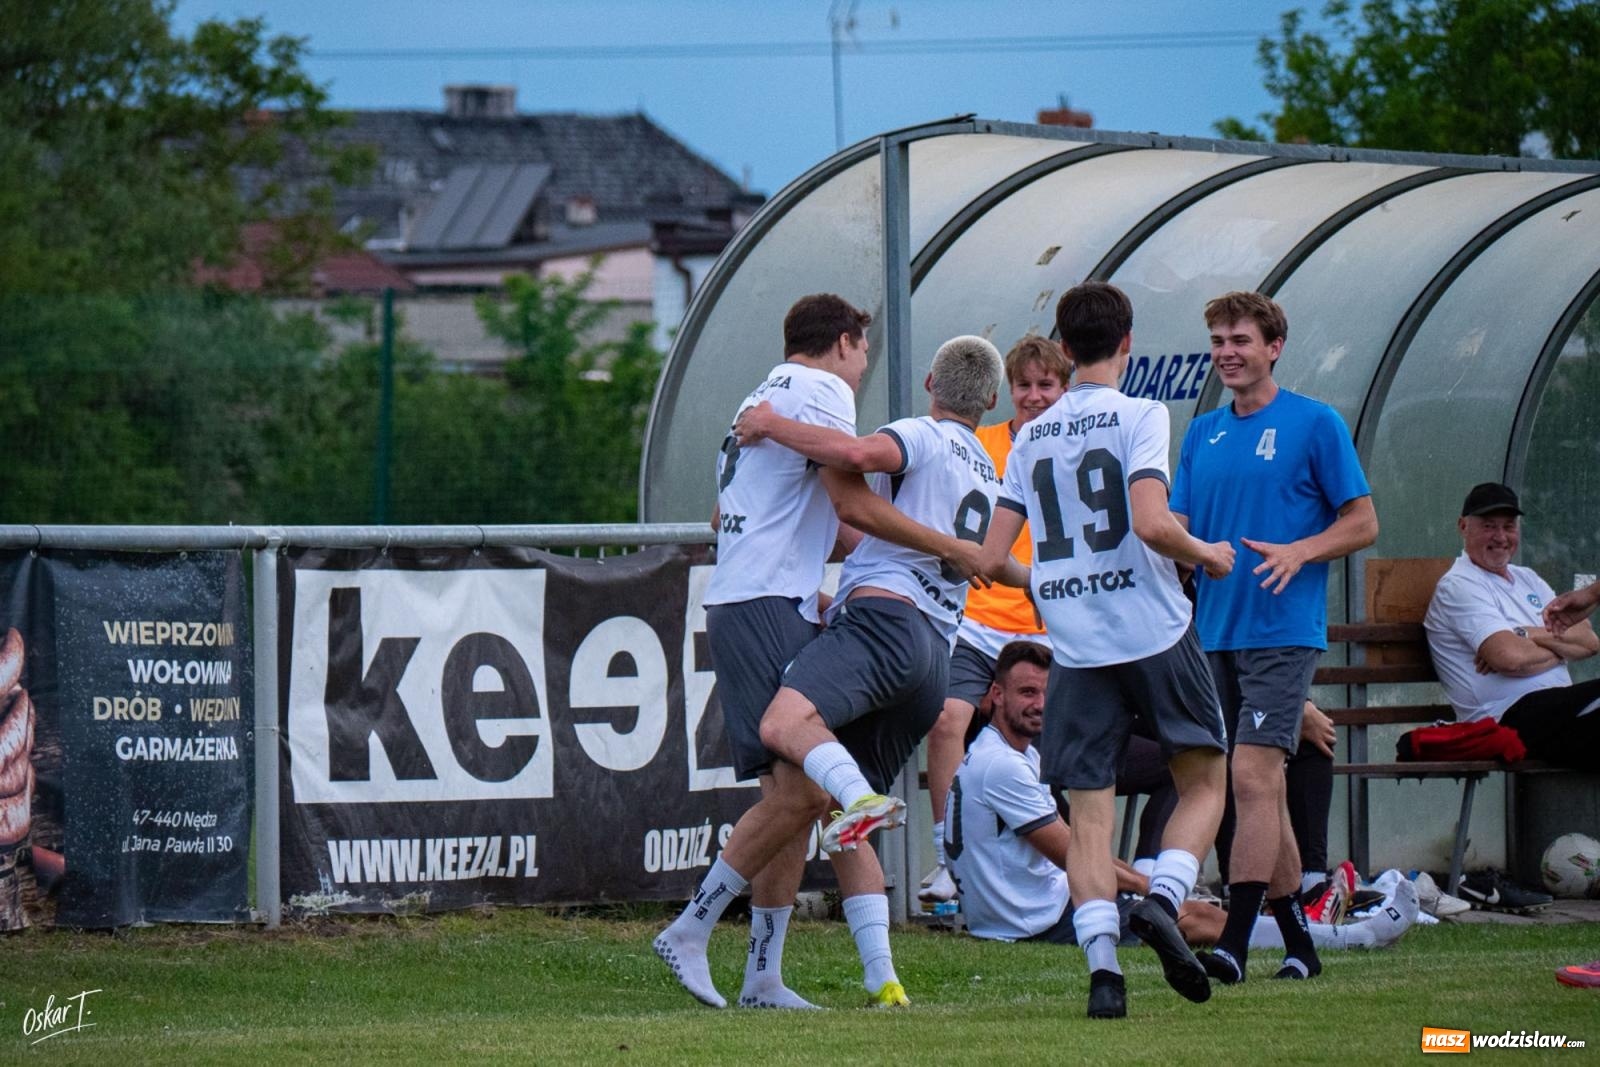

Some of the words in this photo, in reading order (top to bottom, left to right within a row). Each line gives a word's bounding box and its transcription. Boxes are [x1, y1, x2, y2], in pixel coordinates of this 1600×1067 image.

[1029, 422, 1061, 441] 1908
[1067, 411, 1120, 438] NĘDZA
[1256, 428, 1276, 460] 4
[1032, 448, 1130, 563] 19
[1039, 568, 1136, 600] EKO-TOX
[127, 659, 232, 684] WOŁOWINA
[93, 690, 162, 721] DRÓB
[115, 730, 239, 761] GARMAŻERKA
[132, 810, 181, 828] 47-440
[183, 811, 217, 831] Nędza
[131, 836, 161, 852] Jana
[164, 837, 204, 853] Pawła
[207, 837, 214, 852] II
[216, 836, 232, 852] 30
[327, 835, 539, 883] WWW.KEEZA.PL
